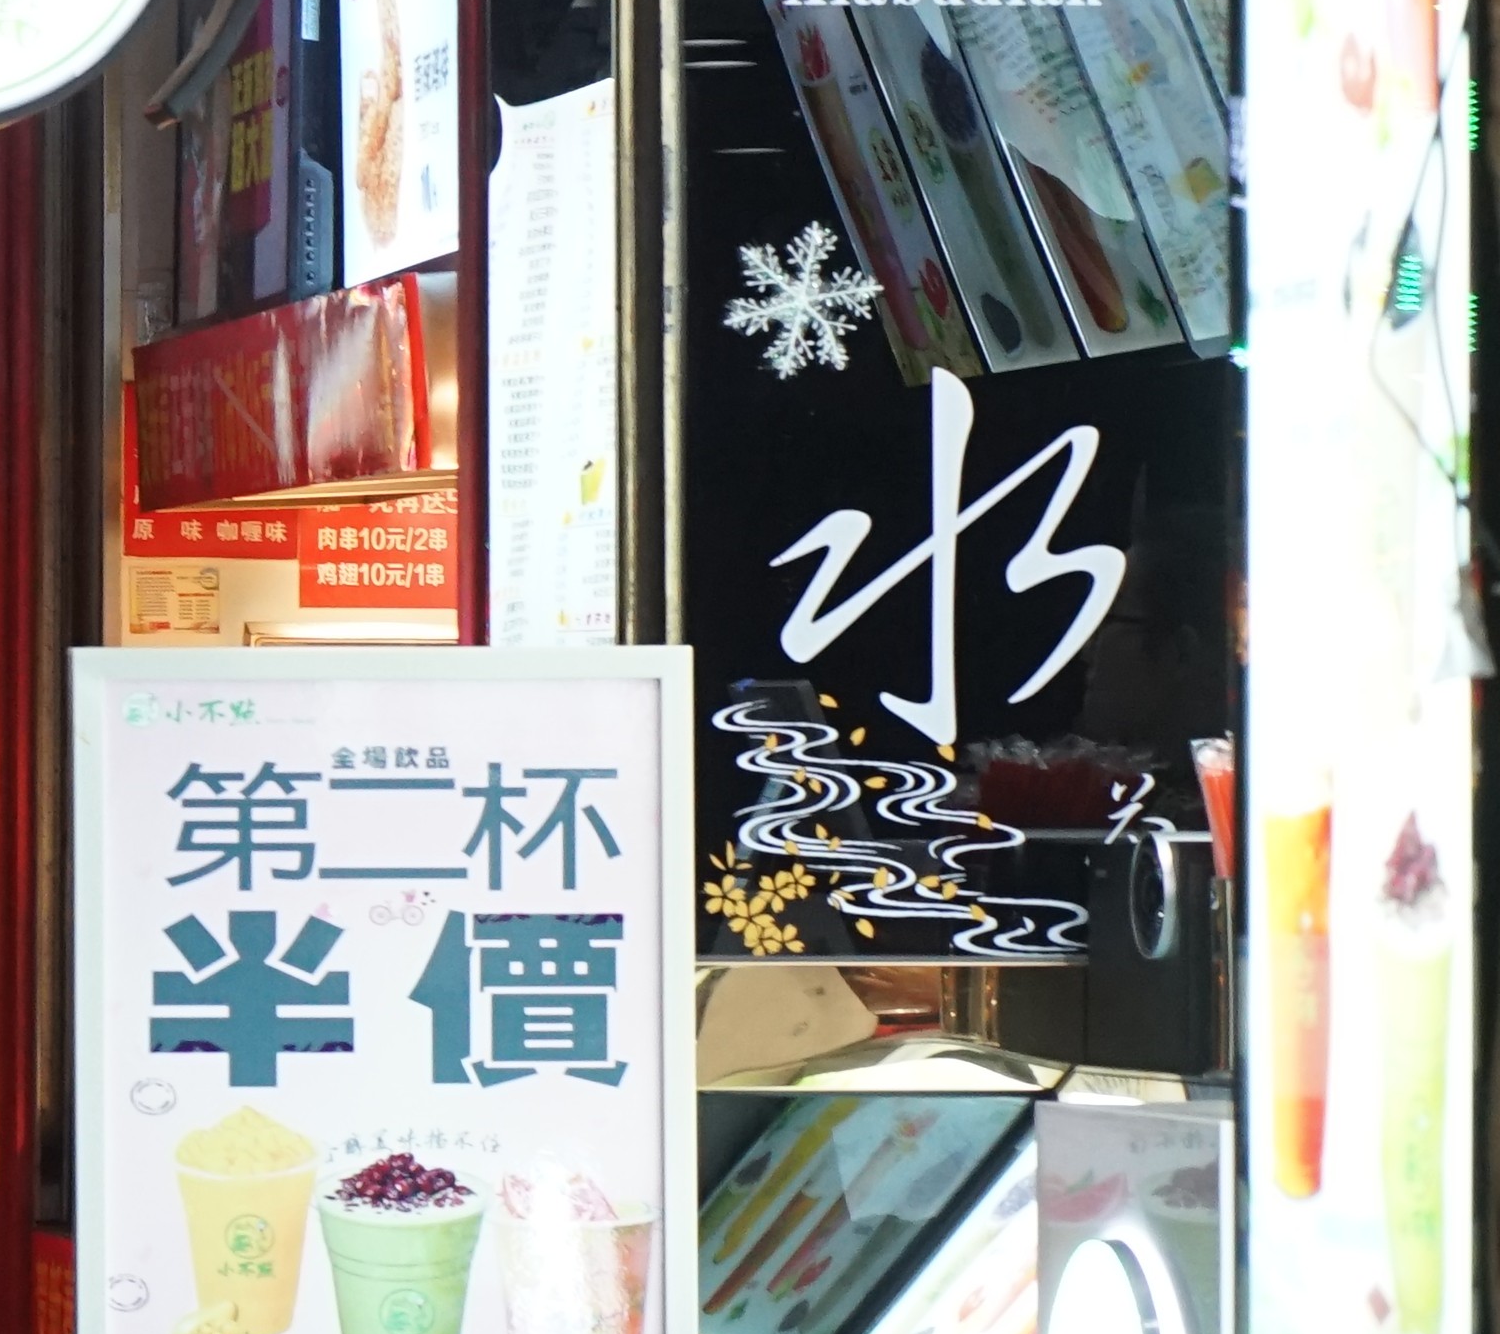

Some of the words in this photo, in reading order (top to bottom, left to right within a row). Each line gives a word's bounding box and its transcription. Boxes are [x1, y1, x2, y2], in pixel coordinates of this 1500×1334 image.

[317, 527, 449, 552] 肉串10元/2串
[769, 367, 1127, 746] 水
[332, 746, 449, 769] 全場飲品
[165, 761, 621, 891] 第二杯
[149, 910, 631, 1088] 半價
